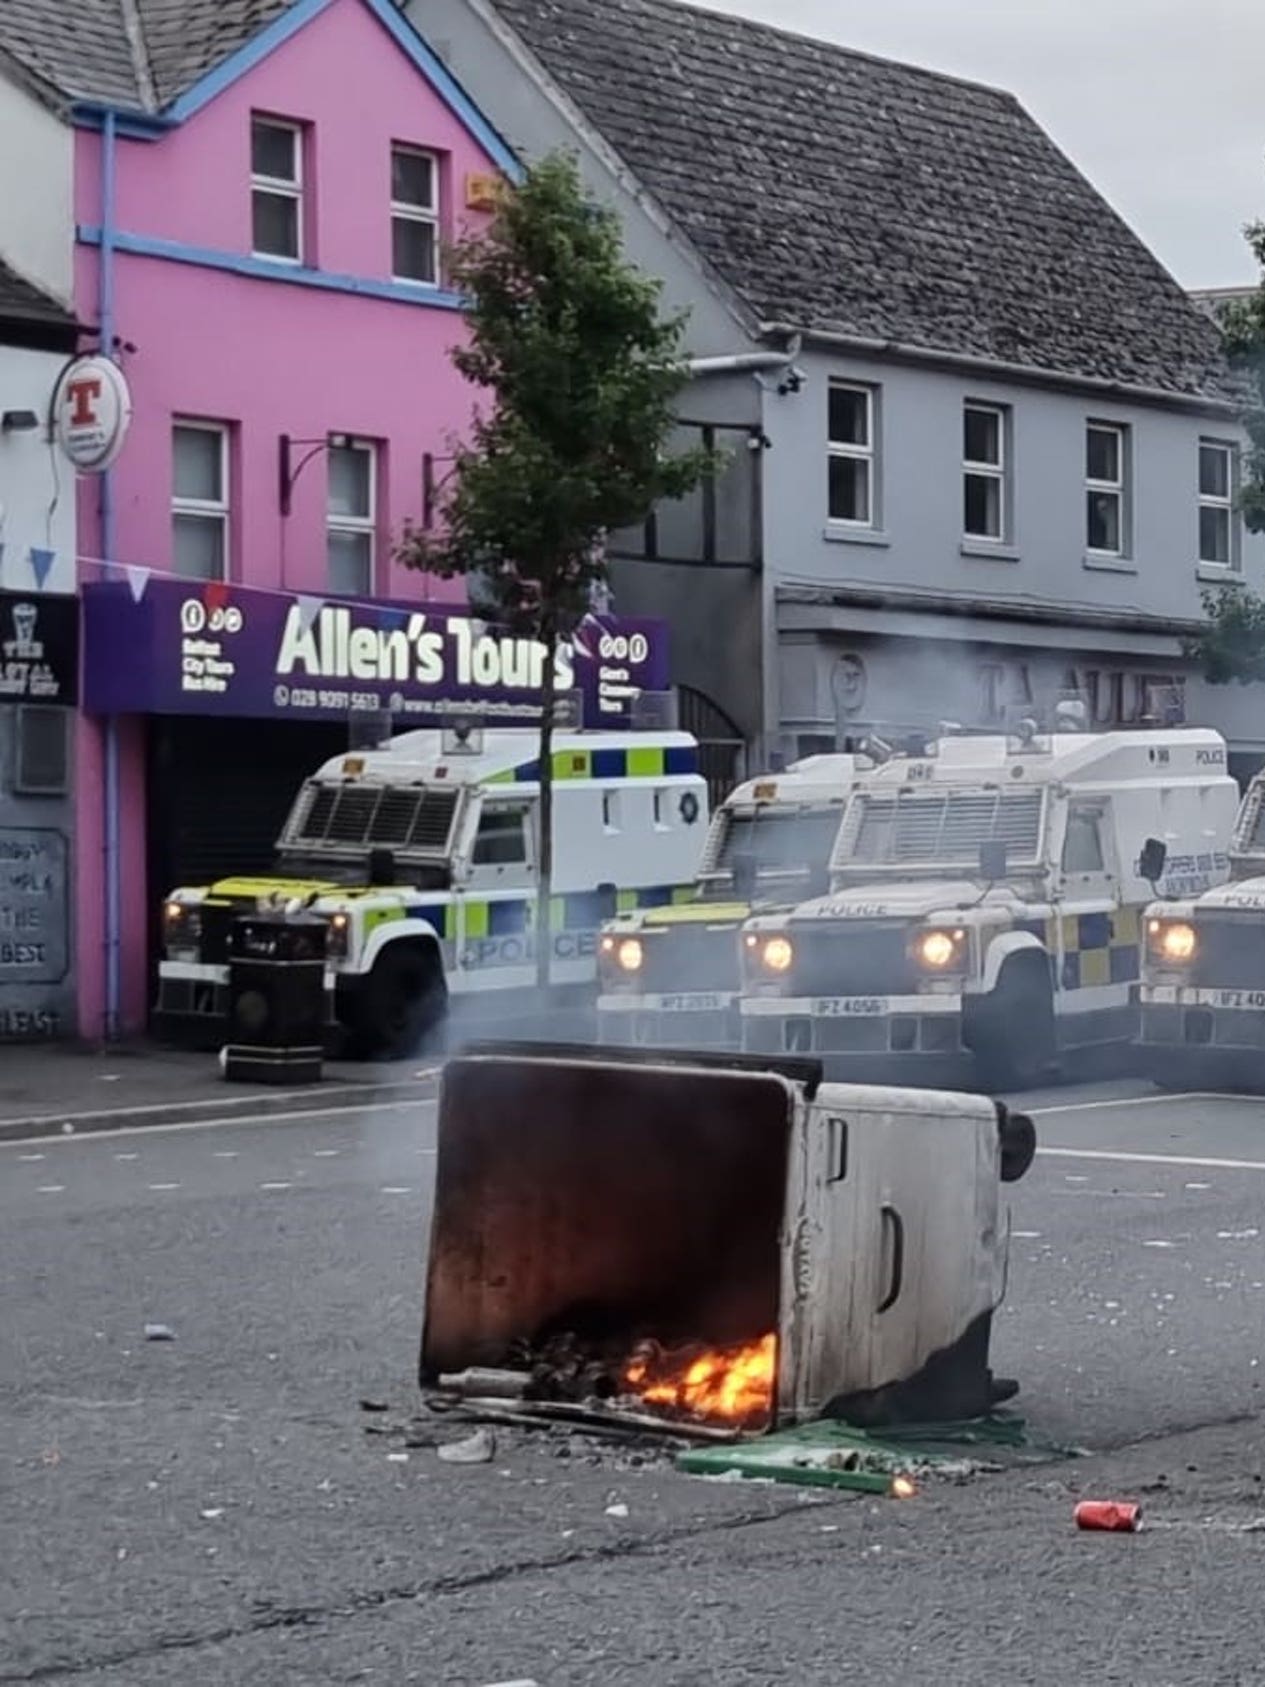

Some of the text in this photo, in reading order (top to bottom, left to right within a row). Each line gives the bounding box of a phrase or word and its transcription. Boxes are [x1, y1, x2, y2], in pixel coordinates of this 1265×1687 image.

[67, 379, 101, 425] T
[276, 604, 574, 690] Allen's Tours
[477, 933, 598, 963] POLCE
